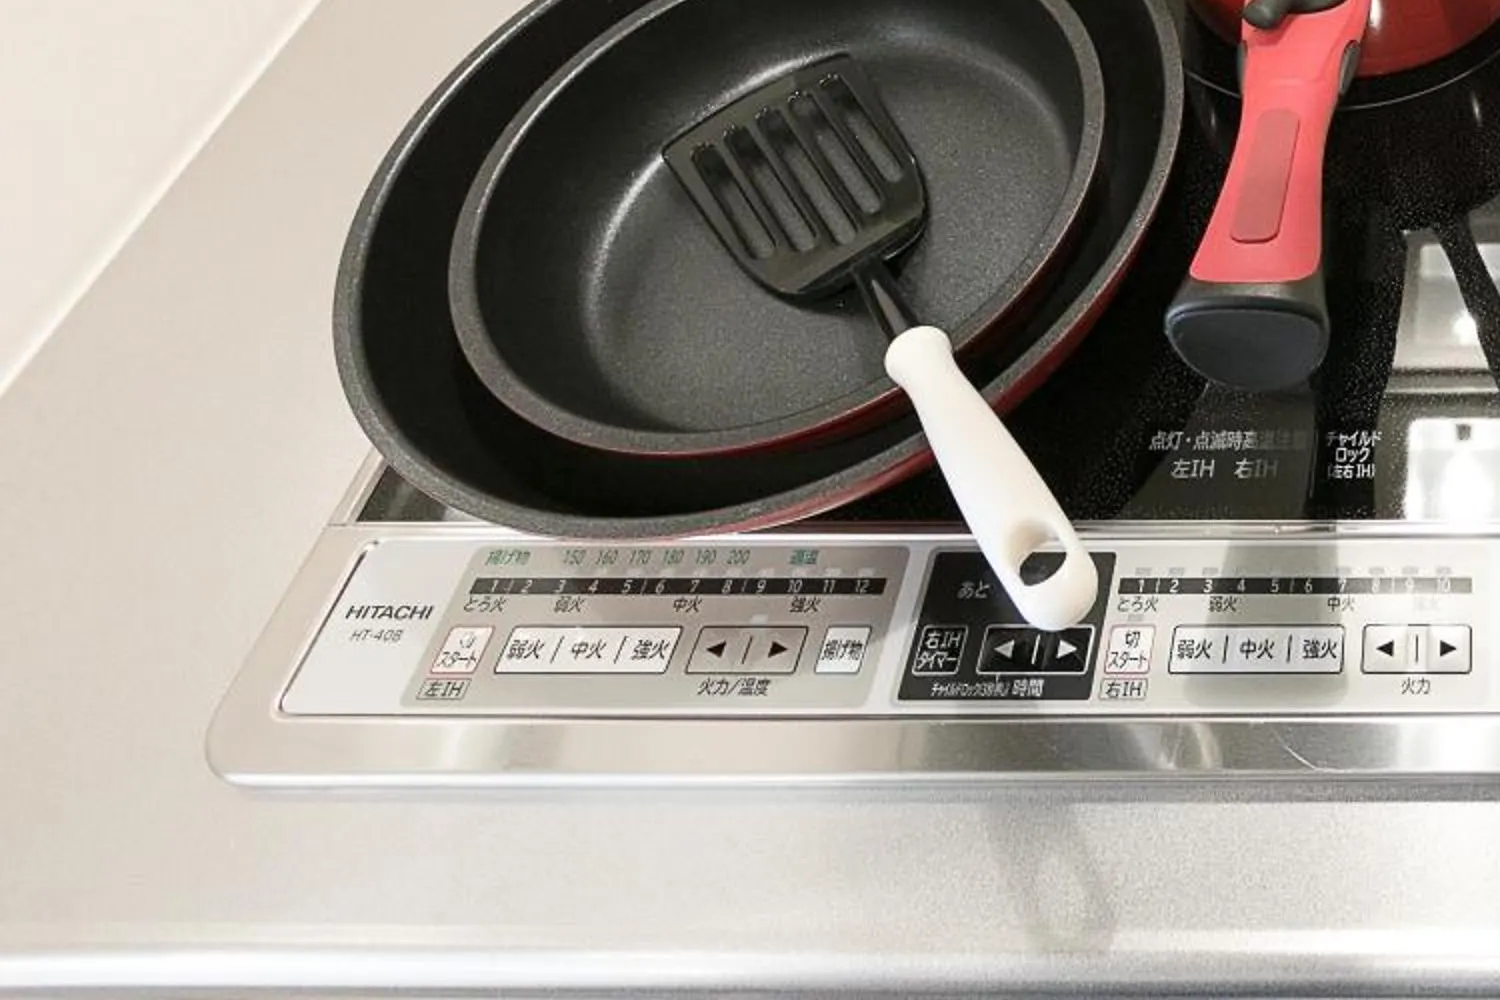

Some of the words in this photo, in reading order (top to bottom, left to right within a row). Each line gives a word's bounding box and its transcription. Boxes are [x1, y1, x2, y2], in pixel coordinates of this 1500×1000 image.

[1335, 447, 1371, 463] ロック
[1171, 458, 1216, 479] 左IH
[1234, 458, 1279, 479] 右IH
[490, 579, 498, 593] 1
[521, 579, 533, 593] 2
[554, 579, 565, 593] 3
[588, 579, 600, 593] 4
[621, 579, 632, 593] 5
[655, 579, 666, 593] 6
[690, 579, 700, 593] 7
[721, 579, 732, 593] 8
[756, 579, 767, 593] 9
[788, 579, 803, 593] 10
[823, 579, 835, 593] 11
[855, 579, 868, 593] 12
[957, 580, 991, 598] あと
[345, 605, 434, 620] HITACHI
[673, 597, 702, 613] 中火
[1208, 597, 1237, 612] 弱火
[1327, 597, 1355, 612] 中火
[924, 630, 962, 648] 右IH
[1124, 631, 1140, 648] 切
[506, 640, 544, 659] 弱火
[571, 640, 606, 659] 中火
[632, 639, 670, 660] 強火
[821, 640, 864, 661] 揚げ物
[1177, 640, 1213, 660] 弱火
[1239, 640, 1275, 660] 中火
[1302, 639, 1337, 660] 強火
[436, 652, 477, 669] スタート
[915, 650, 957, 669] タイマー
[1108, 652, 1147, 669] スタート
[424, 682, 464, 697] 左IH
[698, 679, 770, 696] 火力/温度
[1106, 682, 1143, 697] 右IH
[1401, 678, 1431, 695] 火力
